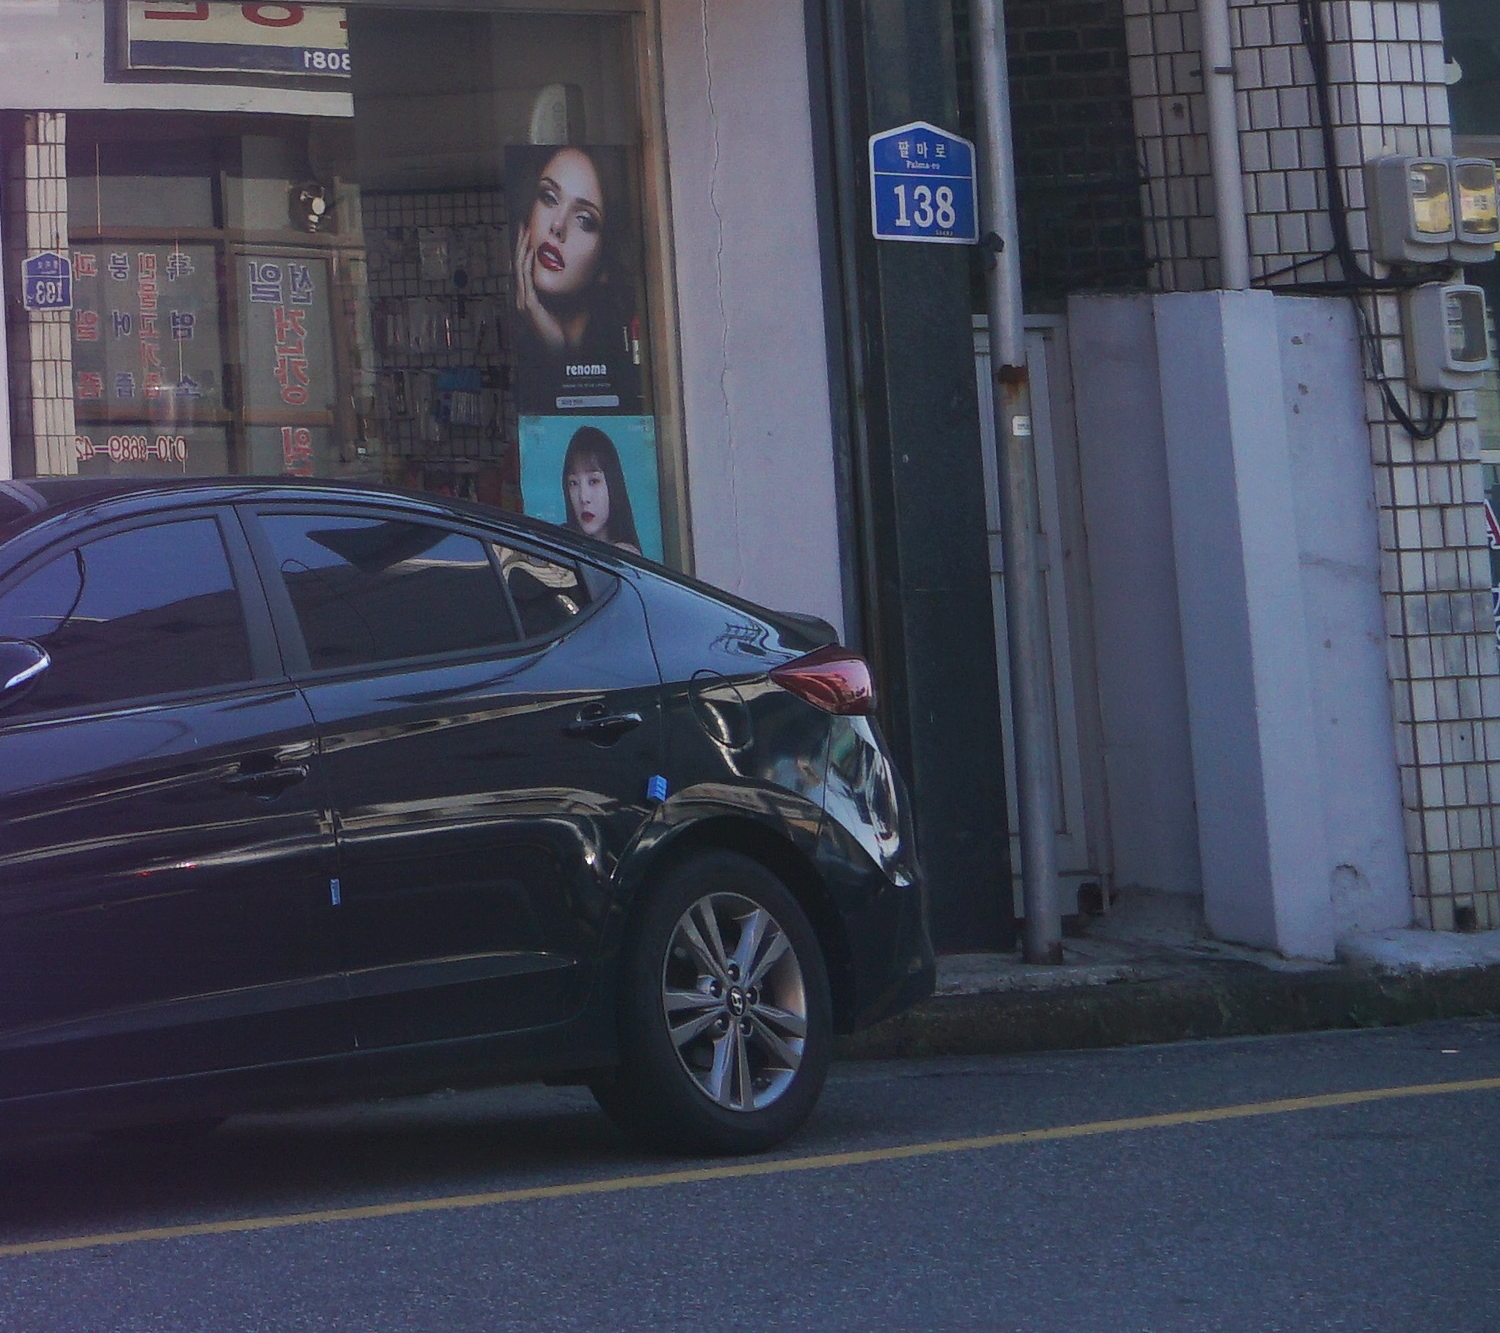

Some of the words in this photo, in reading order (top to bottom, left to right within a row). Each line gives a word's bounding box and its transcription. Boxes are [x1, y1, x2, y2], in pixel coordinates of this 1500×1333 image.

[897, 140, 947, 160] 팔마로
[893, 184, 956, 229] 138
[565, 363, 608, 376] renoma
